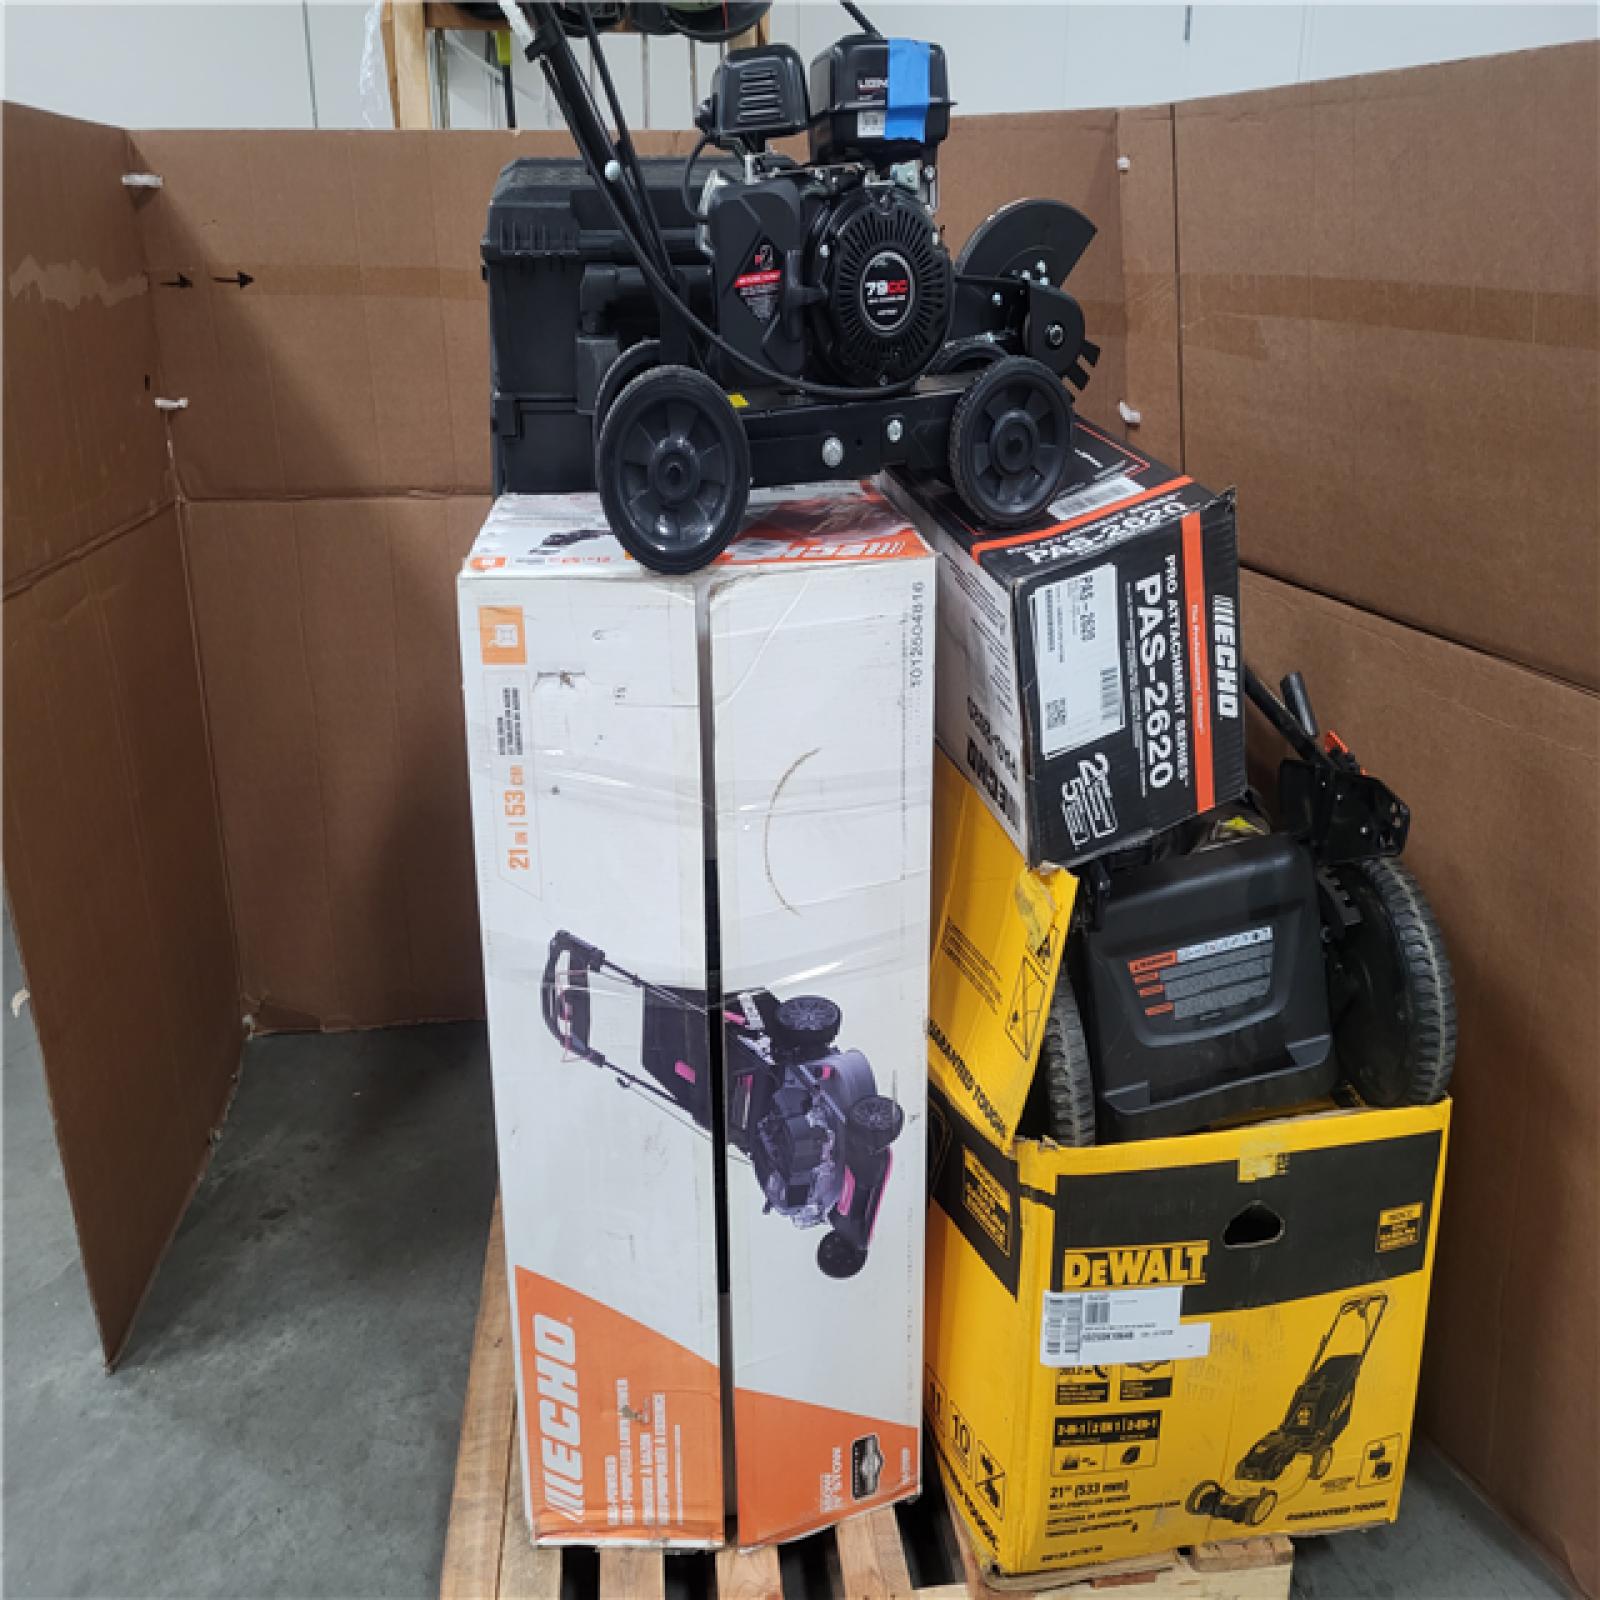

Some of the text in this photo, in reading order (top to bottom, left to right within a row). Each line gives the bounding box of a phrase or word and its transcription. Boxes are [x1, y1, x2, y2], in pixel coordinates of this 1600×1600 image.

[1134, 572, 1174, 789] PAS-2620
[1214, 630, 1239, 718] ECHO
[504, 789, 526, 816] 53
[507, 847, 530, 871] 21
[534, 1313, 583, 1484] ECHO
